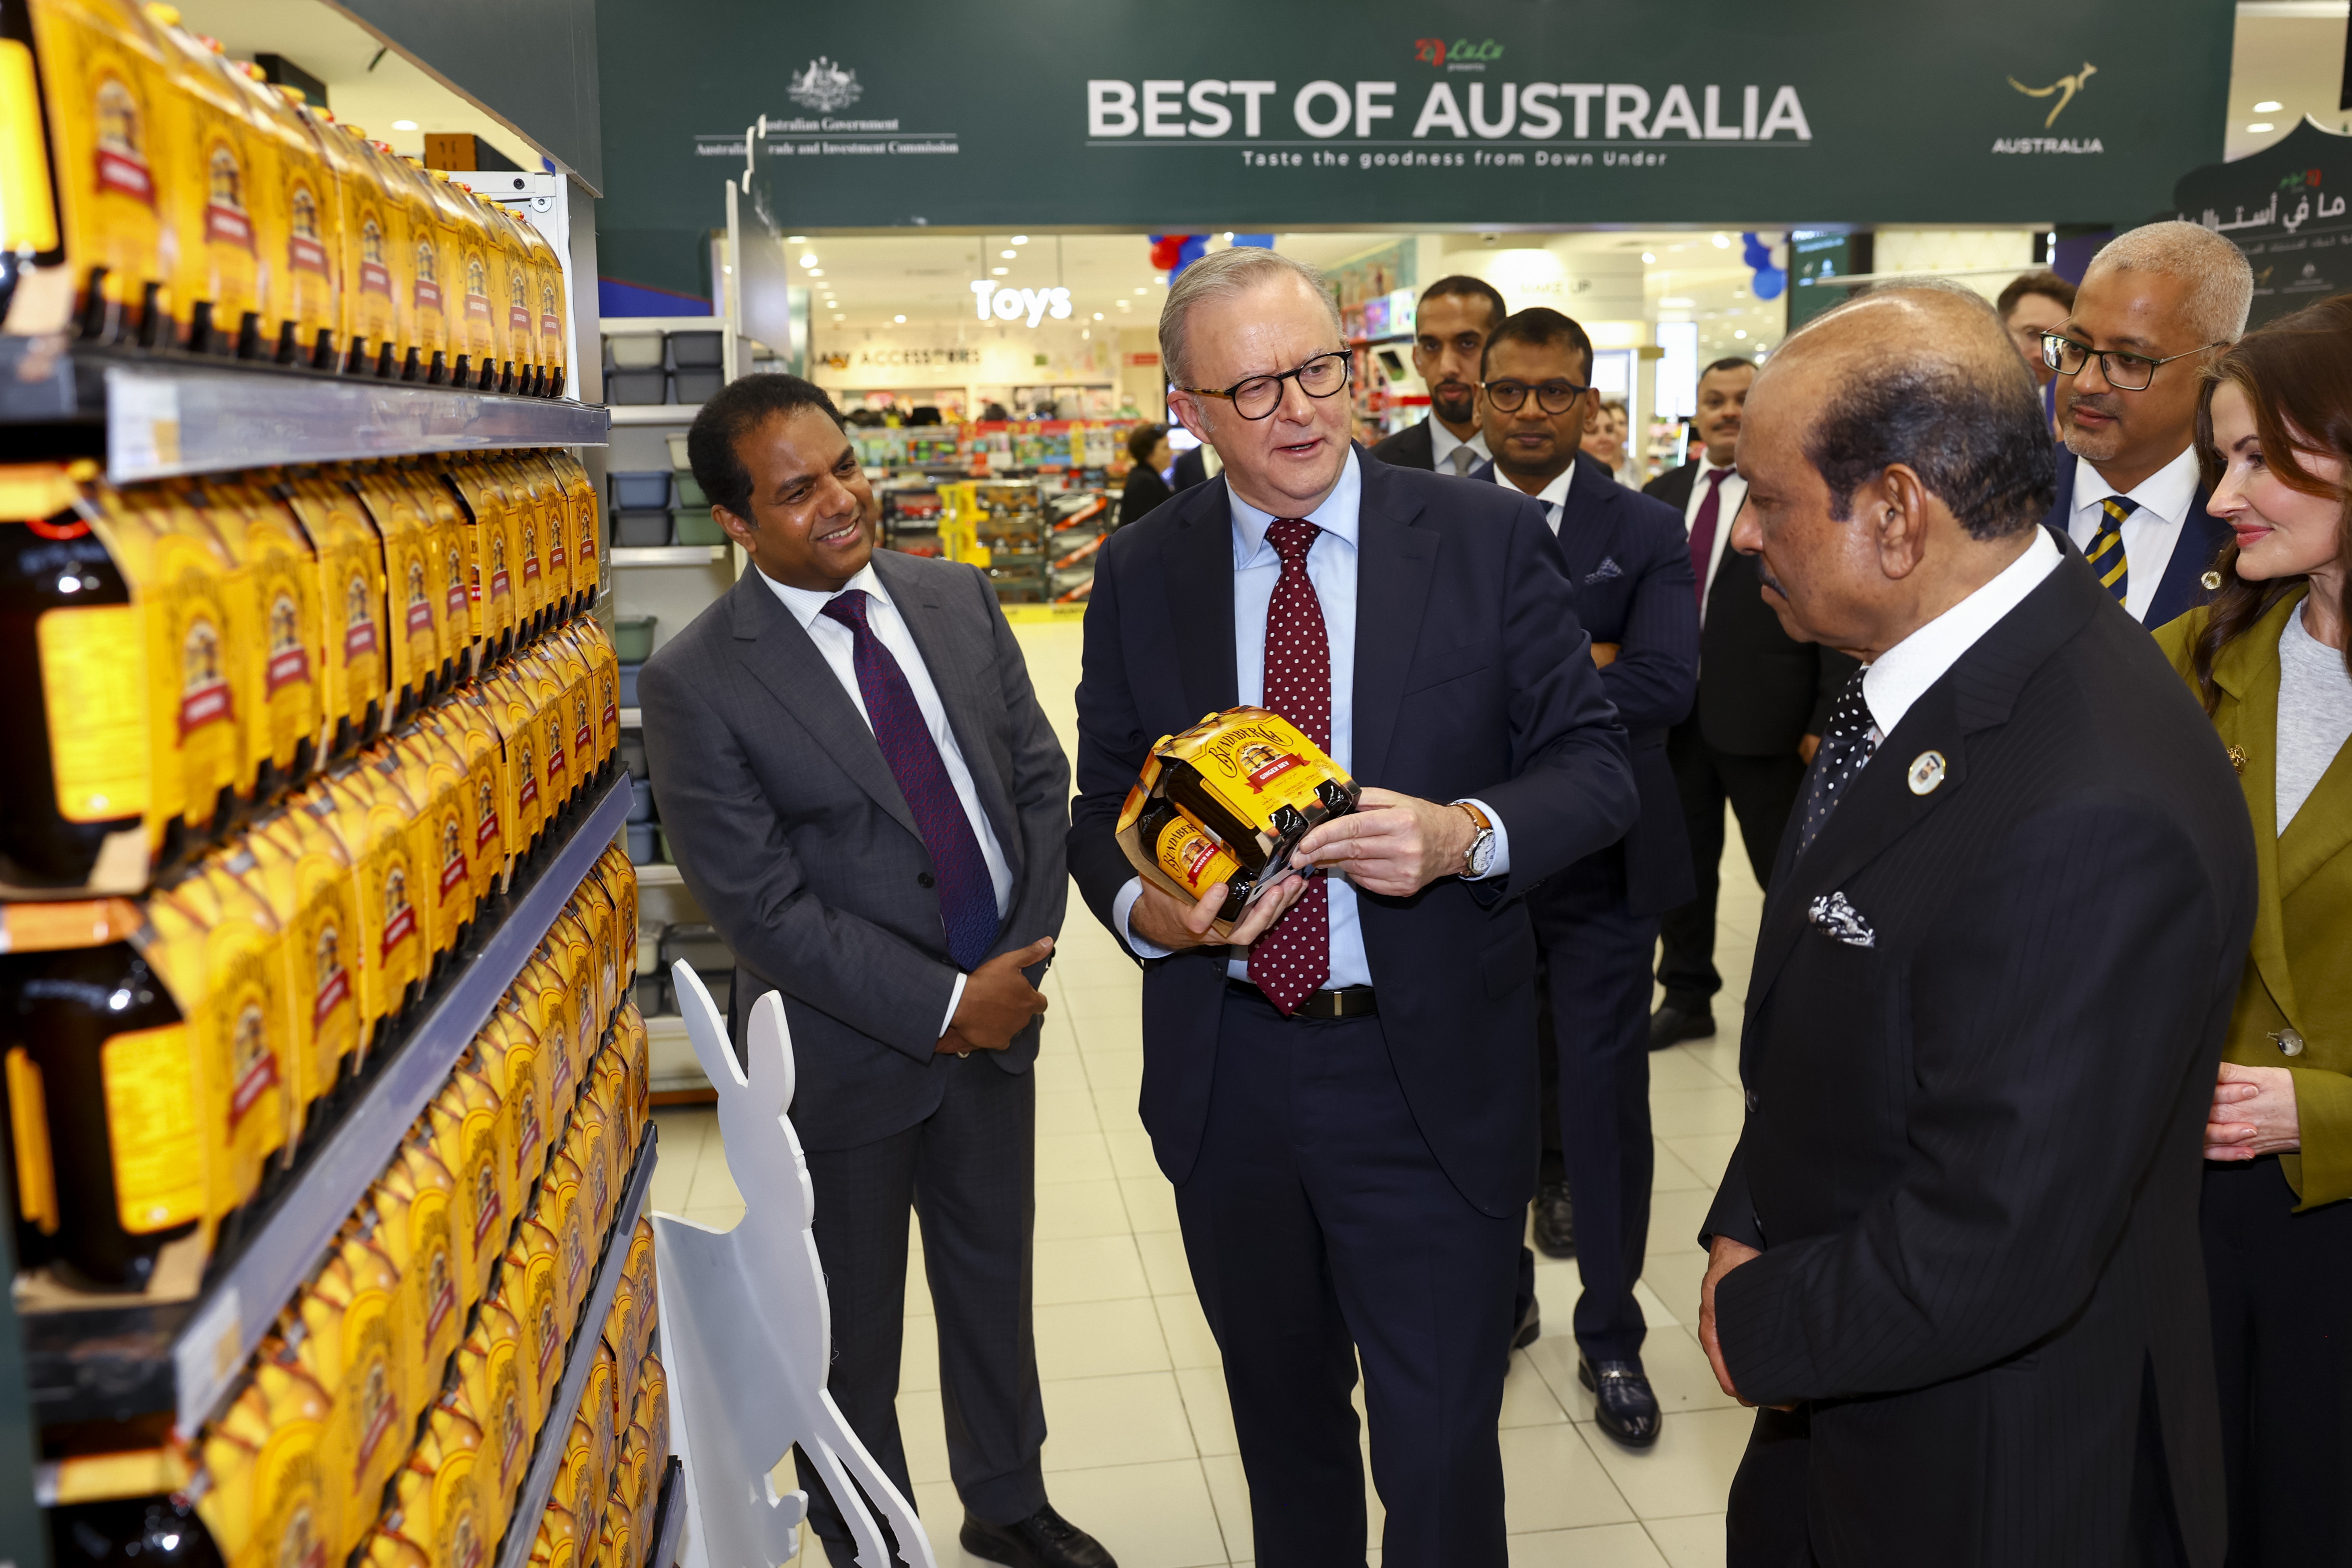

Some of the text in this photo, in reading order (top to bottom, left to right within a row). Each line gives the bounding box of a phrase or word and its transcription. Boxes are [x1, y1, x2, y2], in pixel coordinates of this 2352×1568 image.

[1088, 80, 1811, 140] BEST OF AUSTRALIA
[764, 116, 899, 132] ustralian Government
[696, 140, 959, 156] Australia rade and Investment Commission
[1992, 138, 2104, 154] AUSTRALIA
[1243, 149, 1668, 171] Taste the goodness from Down Under
[2282, 194, 2310, 234] في
[2318, 191, 2346, 218] ما
[971, 280, 1072, 328] Toys
[1208, 724, 1294, 778] BUNDABERG
[1259, 760, 1290, 780] GINGER BEV
[1163, 824, 1199, 879] BUNDABER
[1194, 848, 1214, 873] GINGER BEV
